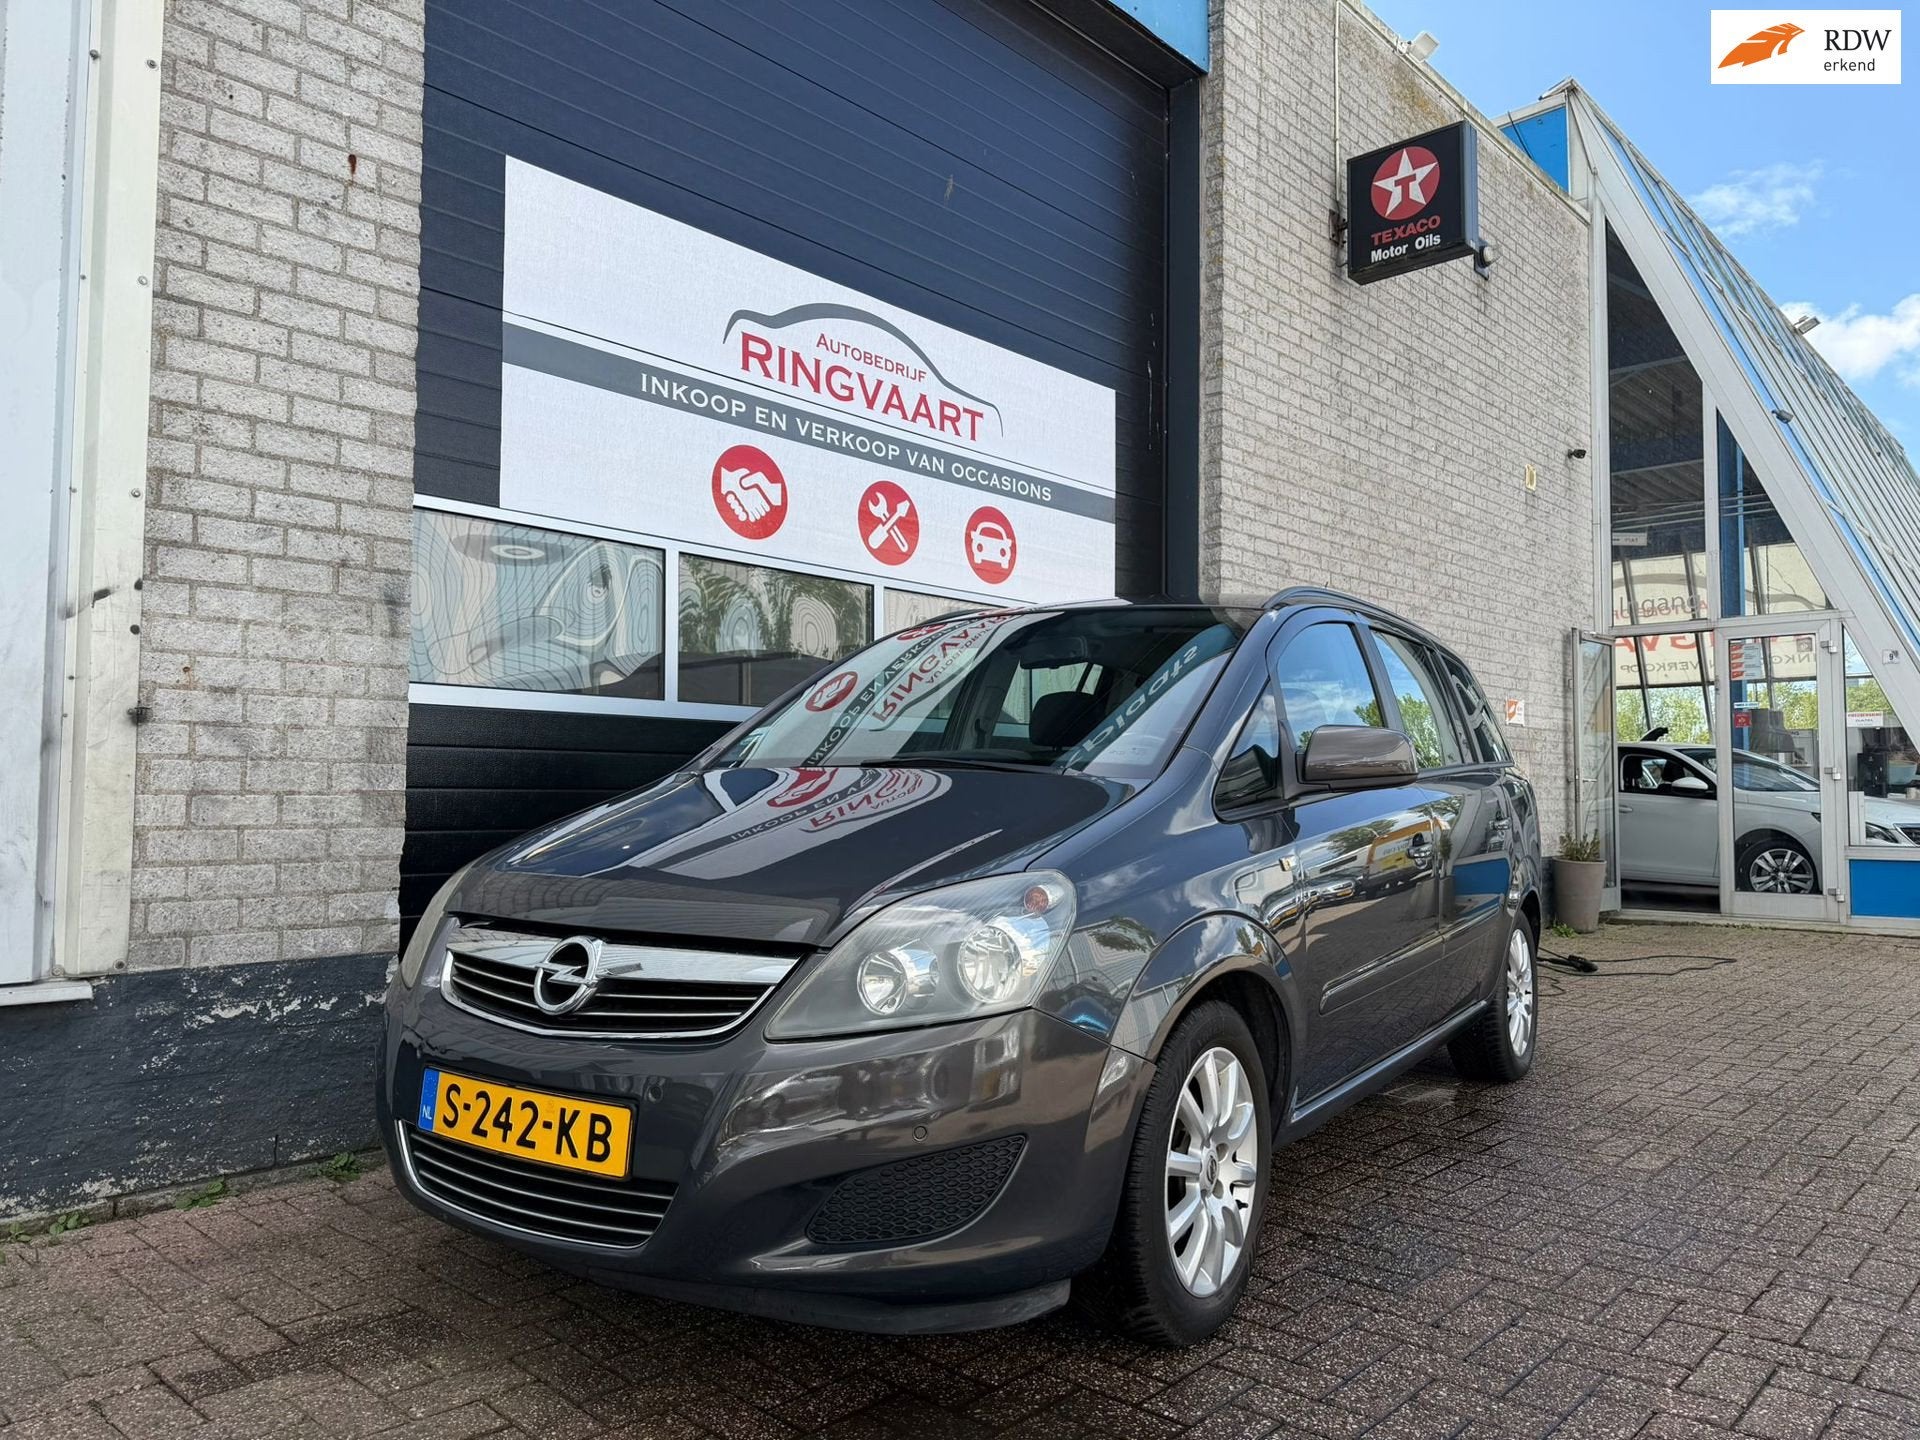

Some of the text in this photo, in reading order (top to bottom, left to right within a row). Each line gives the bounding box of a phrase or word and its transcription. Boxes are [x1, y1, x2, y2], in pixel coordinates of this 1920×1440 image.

[1371, 215, 1441, 246] TEXACO
[1371, 234, 1441, 263] Motor Oils
[816, 333, 926, 383] AUTOBEDRIJF
[740, 331, 984, 442] RINGVAART
[640, 373, 1053, 502] INKOOP EN VERKOOP VAN OCCASIONS
[421, 1106, 433, 1120] NL
[442, 1083, 613, 1163] S-242-KB
